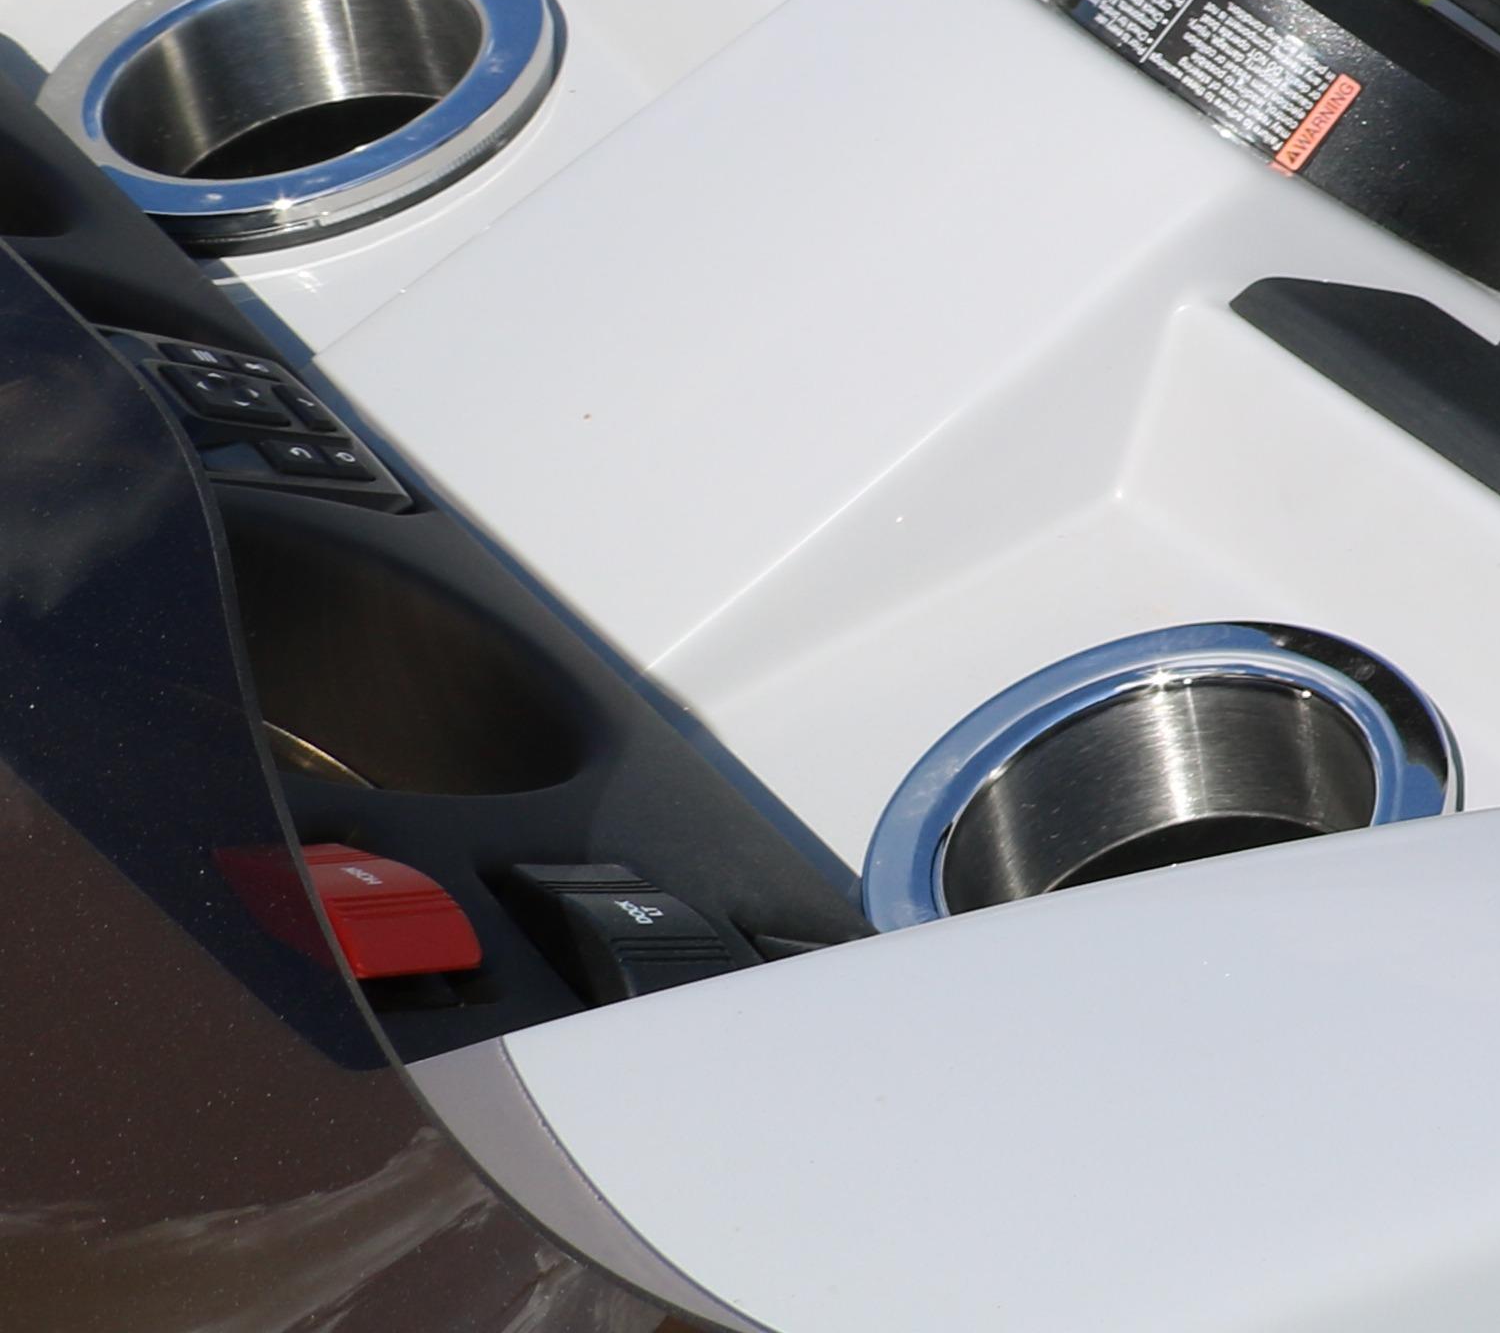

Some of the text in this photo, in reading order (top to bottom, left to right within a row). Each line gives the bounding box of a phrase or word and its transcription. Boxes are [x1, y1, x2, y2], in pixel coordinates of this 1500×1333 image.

[1299, 81, 1355, 153] WARNING
[614, 900, 653, 925] DOCK
[640, 905, 663, 918] LT
